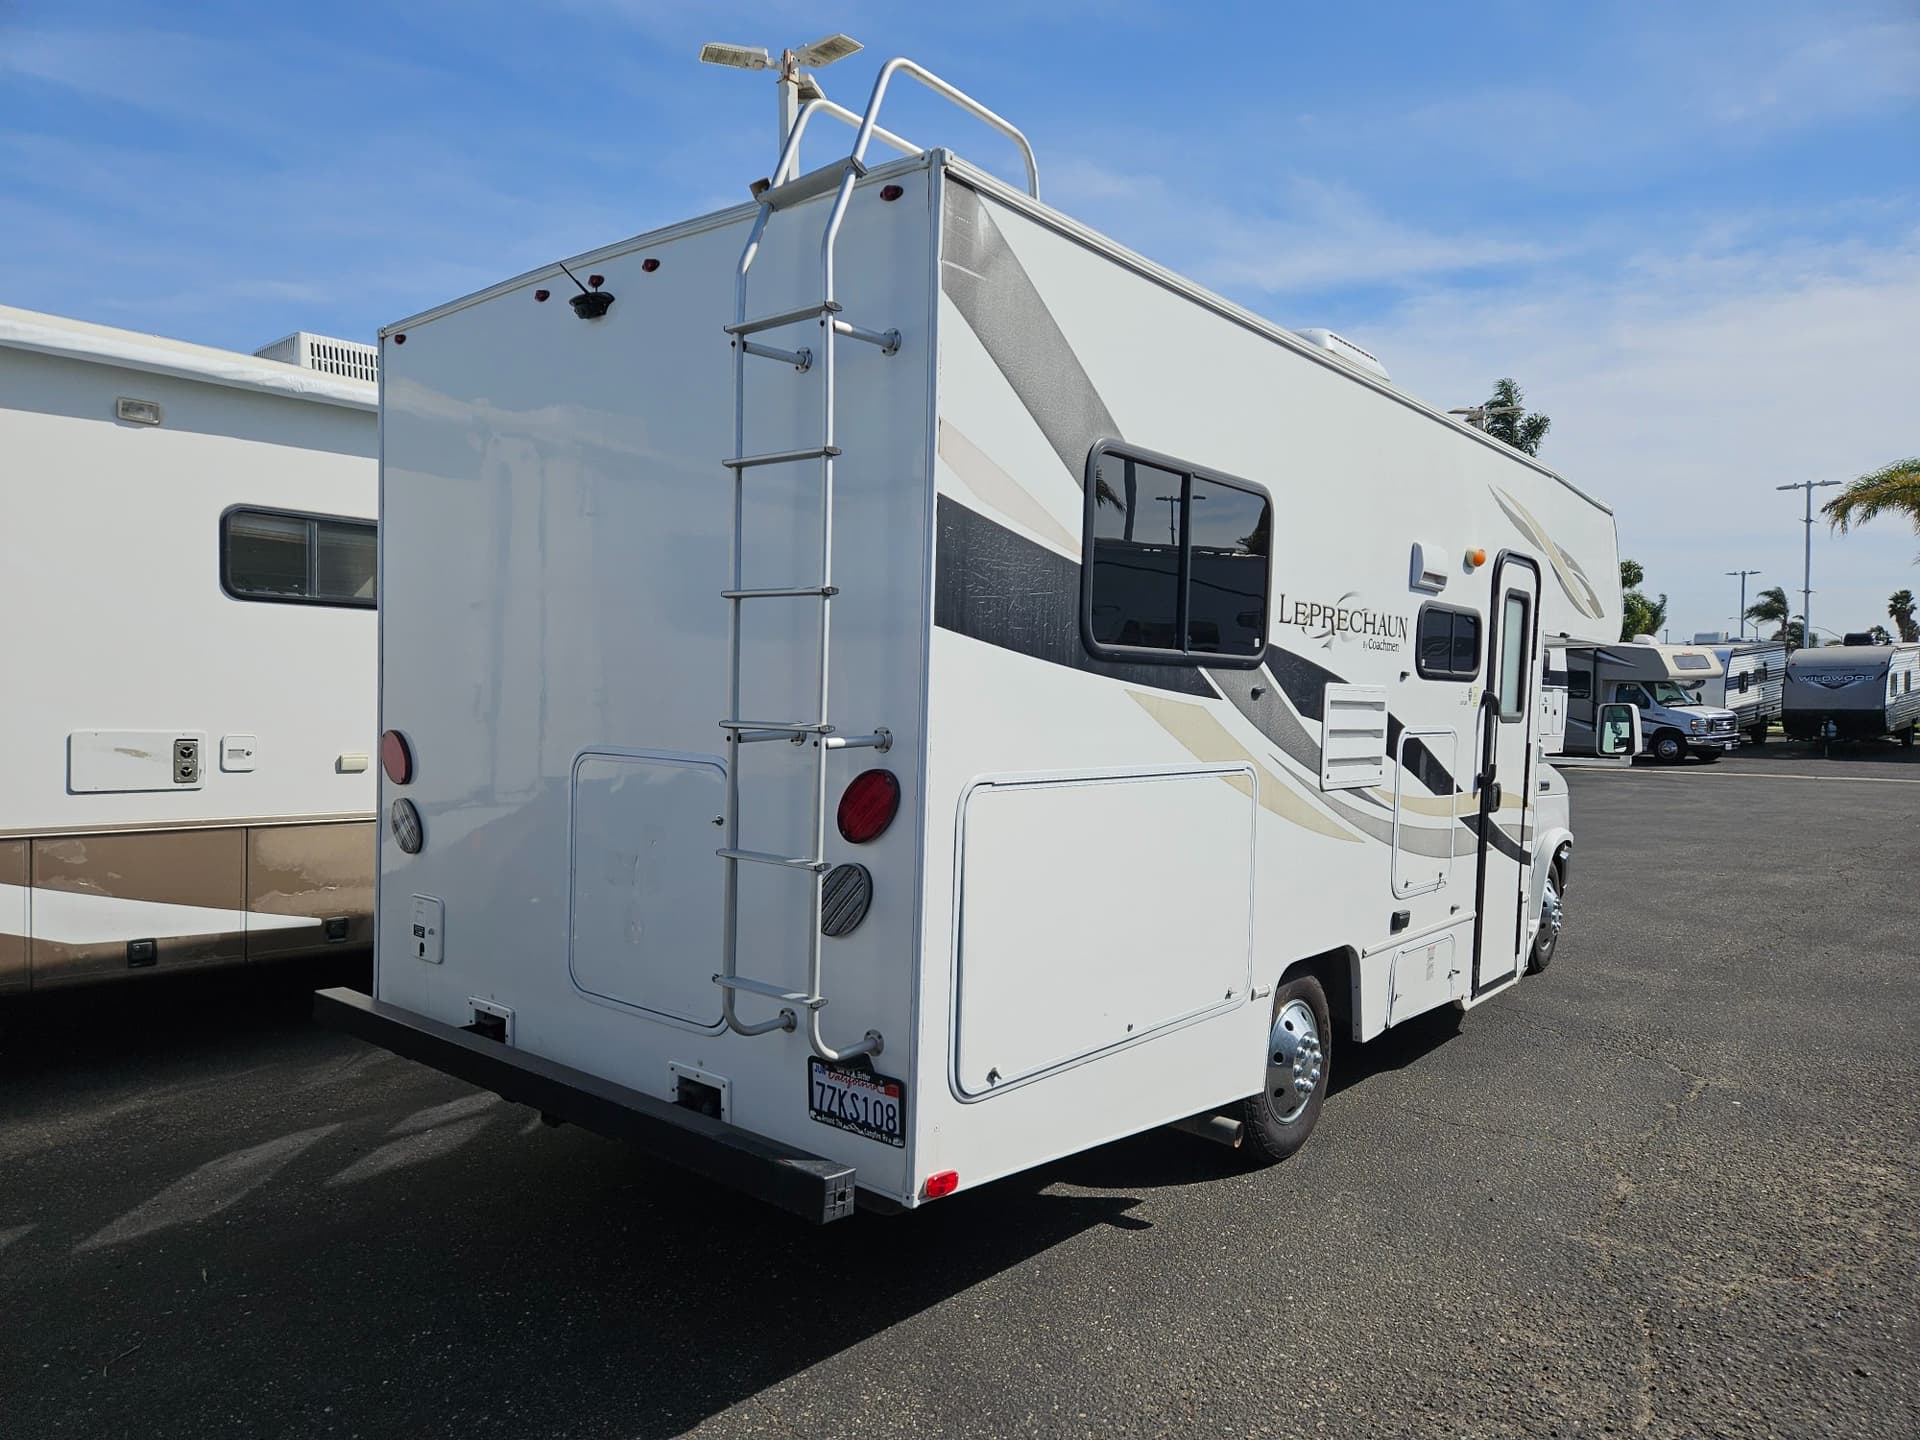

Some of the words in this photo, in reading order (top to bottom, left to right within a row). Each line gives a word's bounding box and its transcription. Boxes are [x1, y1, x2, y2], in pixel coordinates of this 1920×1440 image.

[1278, 592, 1408, 643] LEPRECHAUN
[1368, 638, 1400, 653] Coachmen
[1798, 674, 1874, 682] WILDWOOD
[815, 1081, 897, 1133] 7ZKS108
